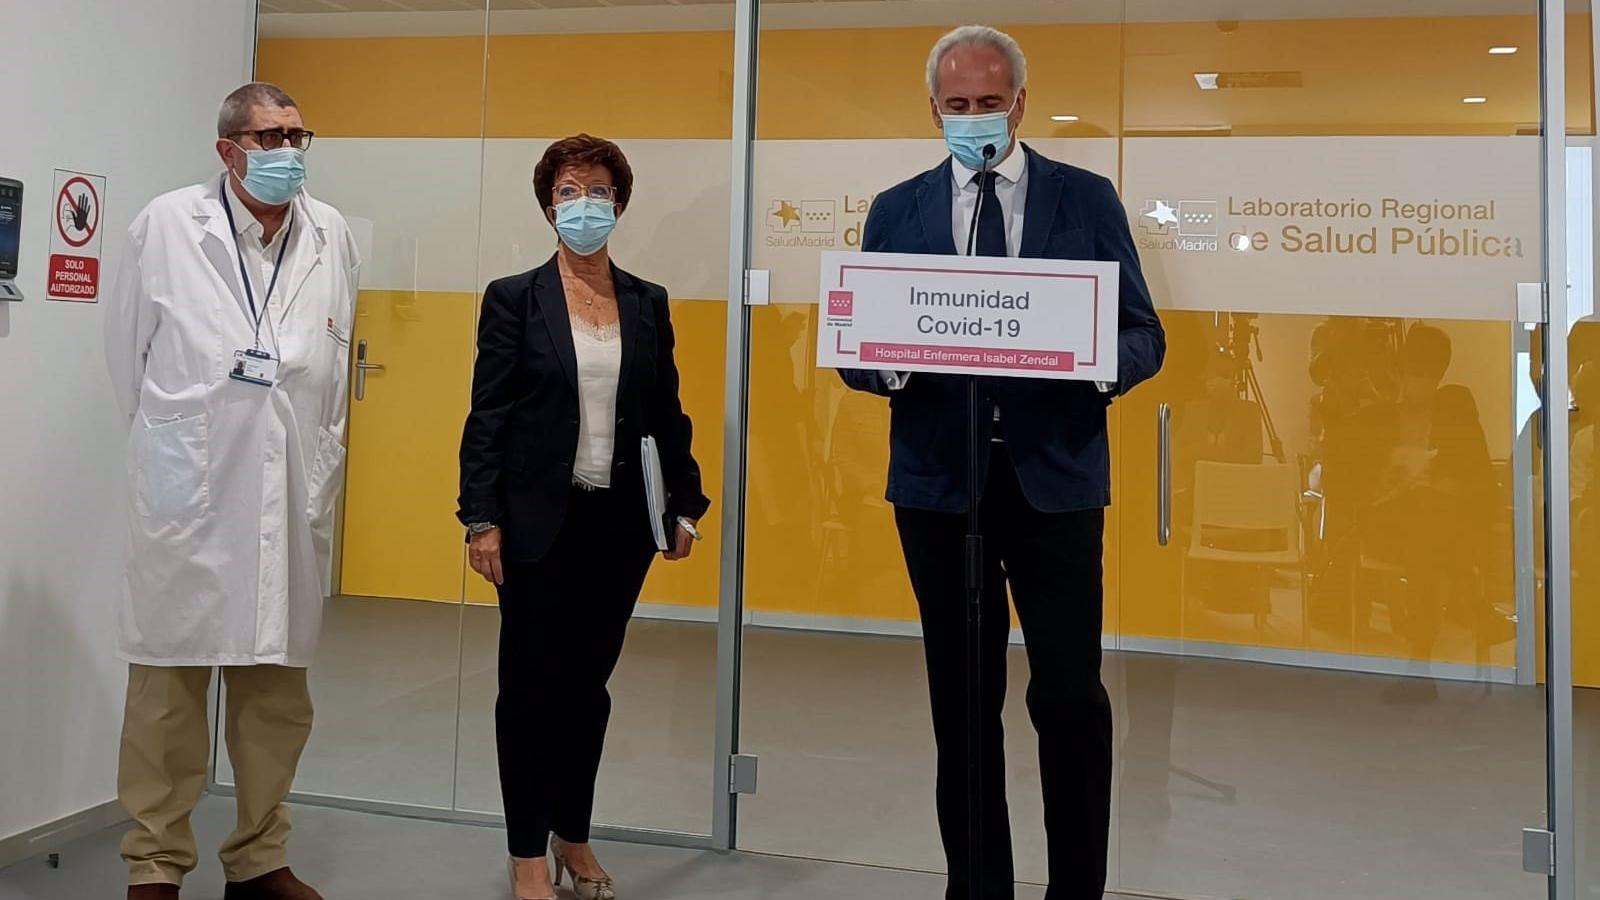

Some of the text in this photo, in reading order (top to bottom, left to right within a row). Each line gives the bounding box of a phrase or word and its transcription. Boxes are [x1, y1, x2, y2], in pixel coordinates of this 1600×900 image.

[1228, 196, 1495, 224] Laboratorio Regional
[766, 236, 835, 248] SaludMadrid
[1139, 238, 1218, 252] SaludMadrid
[1281, 225, 1377, 255] Salud
[1391, 227, 1524, 258] Pública
[65, 259, 84, 270] SOLO
[55, 270, 92, 283] PERSONAL
[51, 283, 95, 295] AUTORIZADO
[909, 286, 1030, 310] Inmunidad
[916, 314, 1021, 338] Covid-19
[875, 347, 1059, 366] Hospital Enfermera Isabel Zendal
